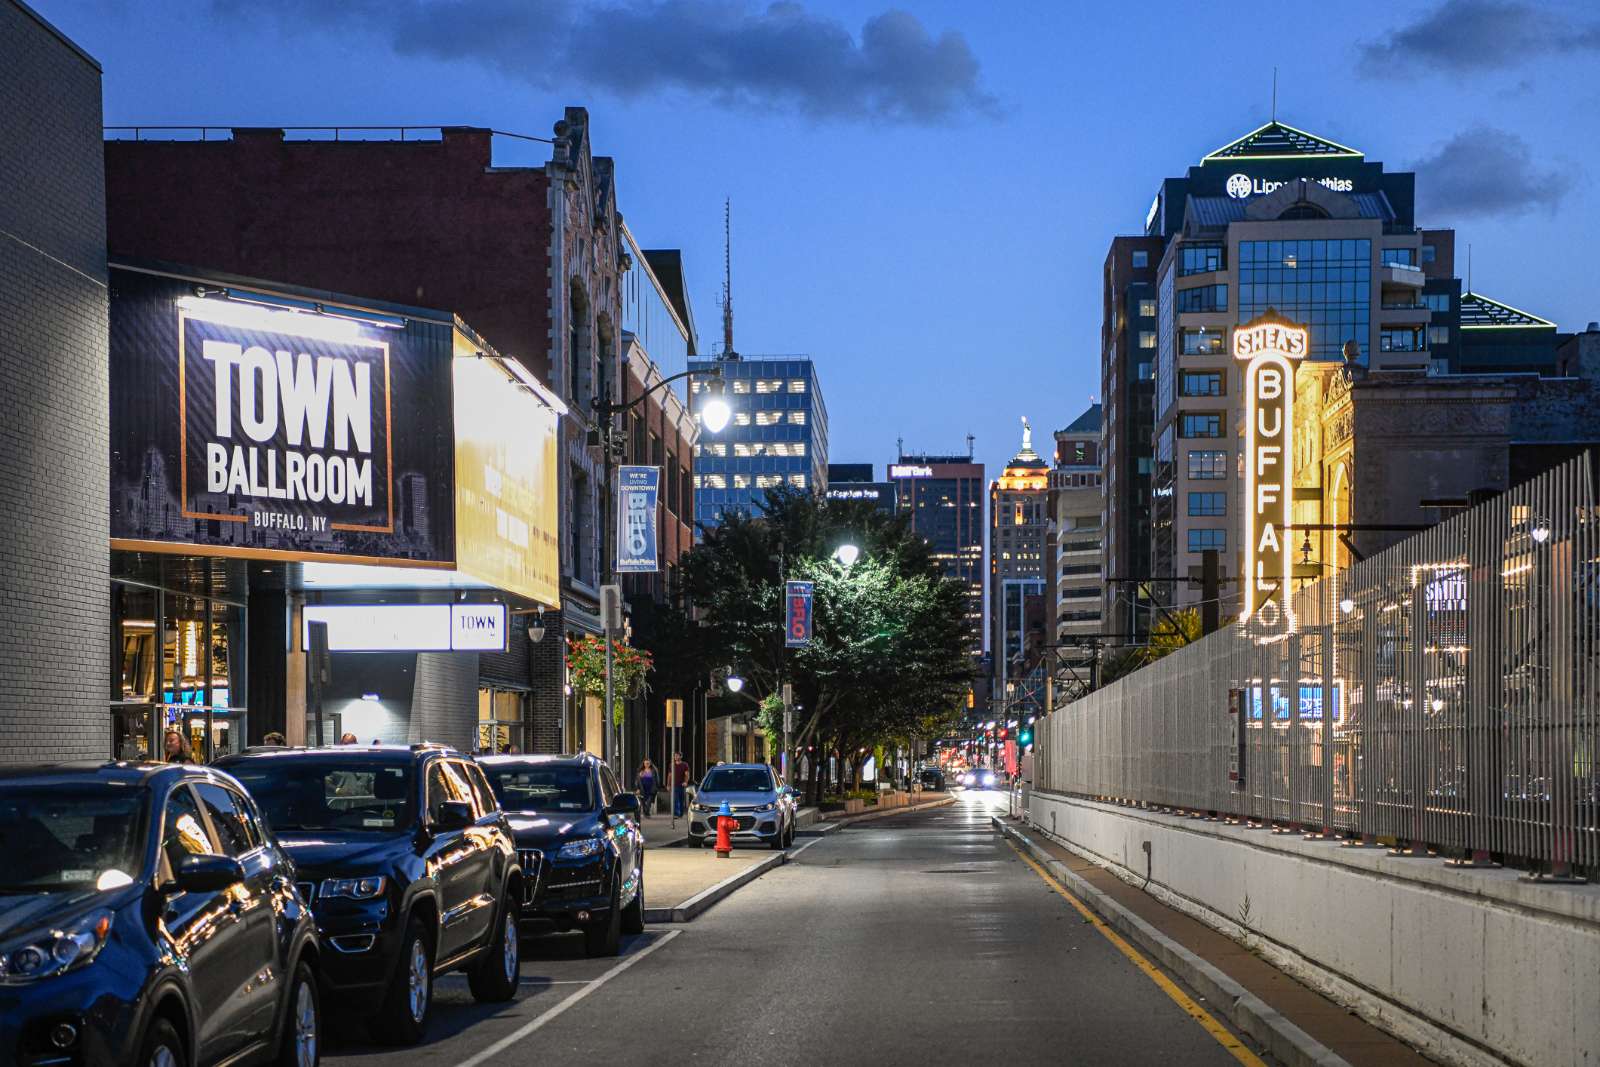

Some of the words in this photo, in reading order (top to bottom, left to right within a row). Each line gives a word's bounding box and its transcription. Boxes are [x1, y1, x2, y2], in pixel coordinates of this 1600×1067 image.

[203, 340, 372, 453] TOWN
[207, 442, 373, 507] BALLROOM
[1257, 369, 1282, 626] BUFFALO
[312, 515, 327, 532] NY
[628, 492, 648, 556] BFLO
[461, 615, 496, 629] TOWN
